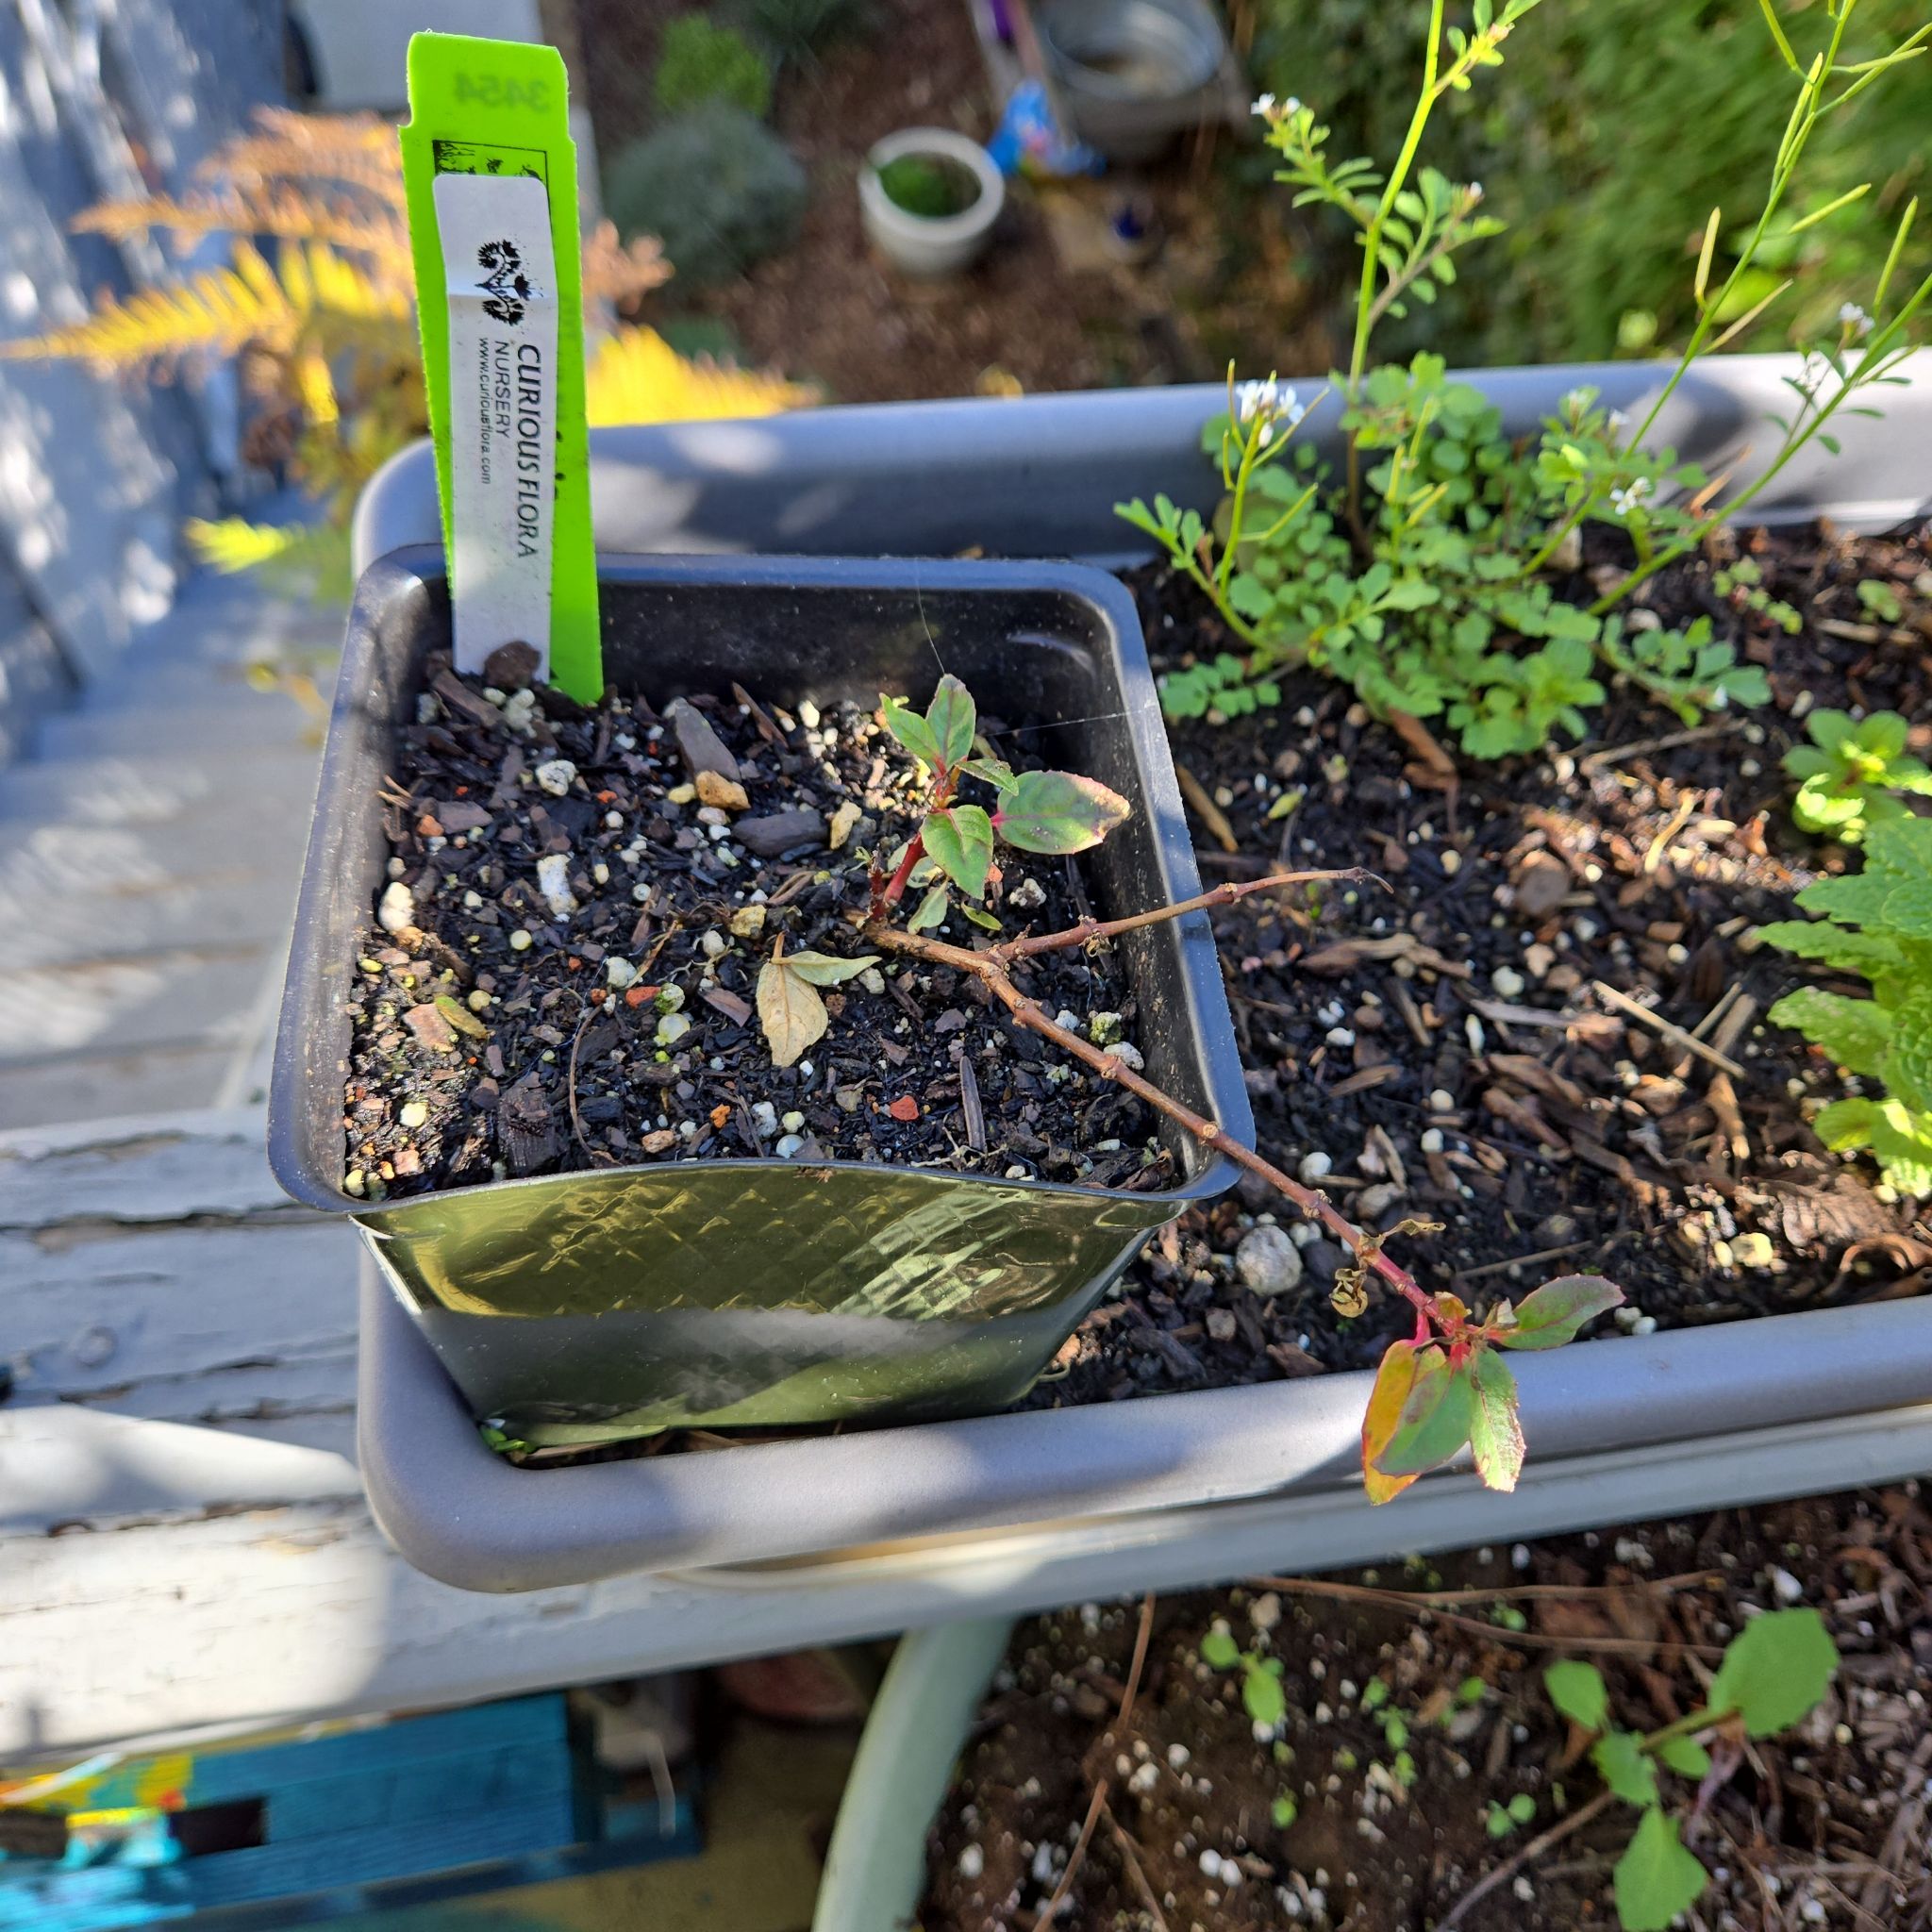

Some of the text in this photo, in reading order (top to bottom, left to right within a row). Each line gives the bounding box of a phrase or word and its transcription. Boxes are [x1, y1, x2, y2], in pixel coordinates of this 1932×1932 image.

[478, 338, 491, 485] www.curiousflora.com
[493, 341, 511, 439] NURSERY
[517, 343, 541, 558] CURIOUS FLORA
